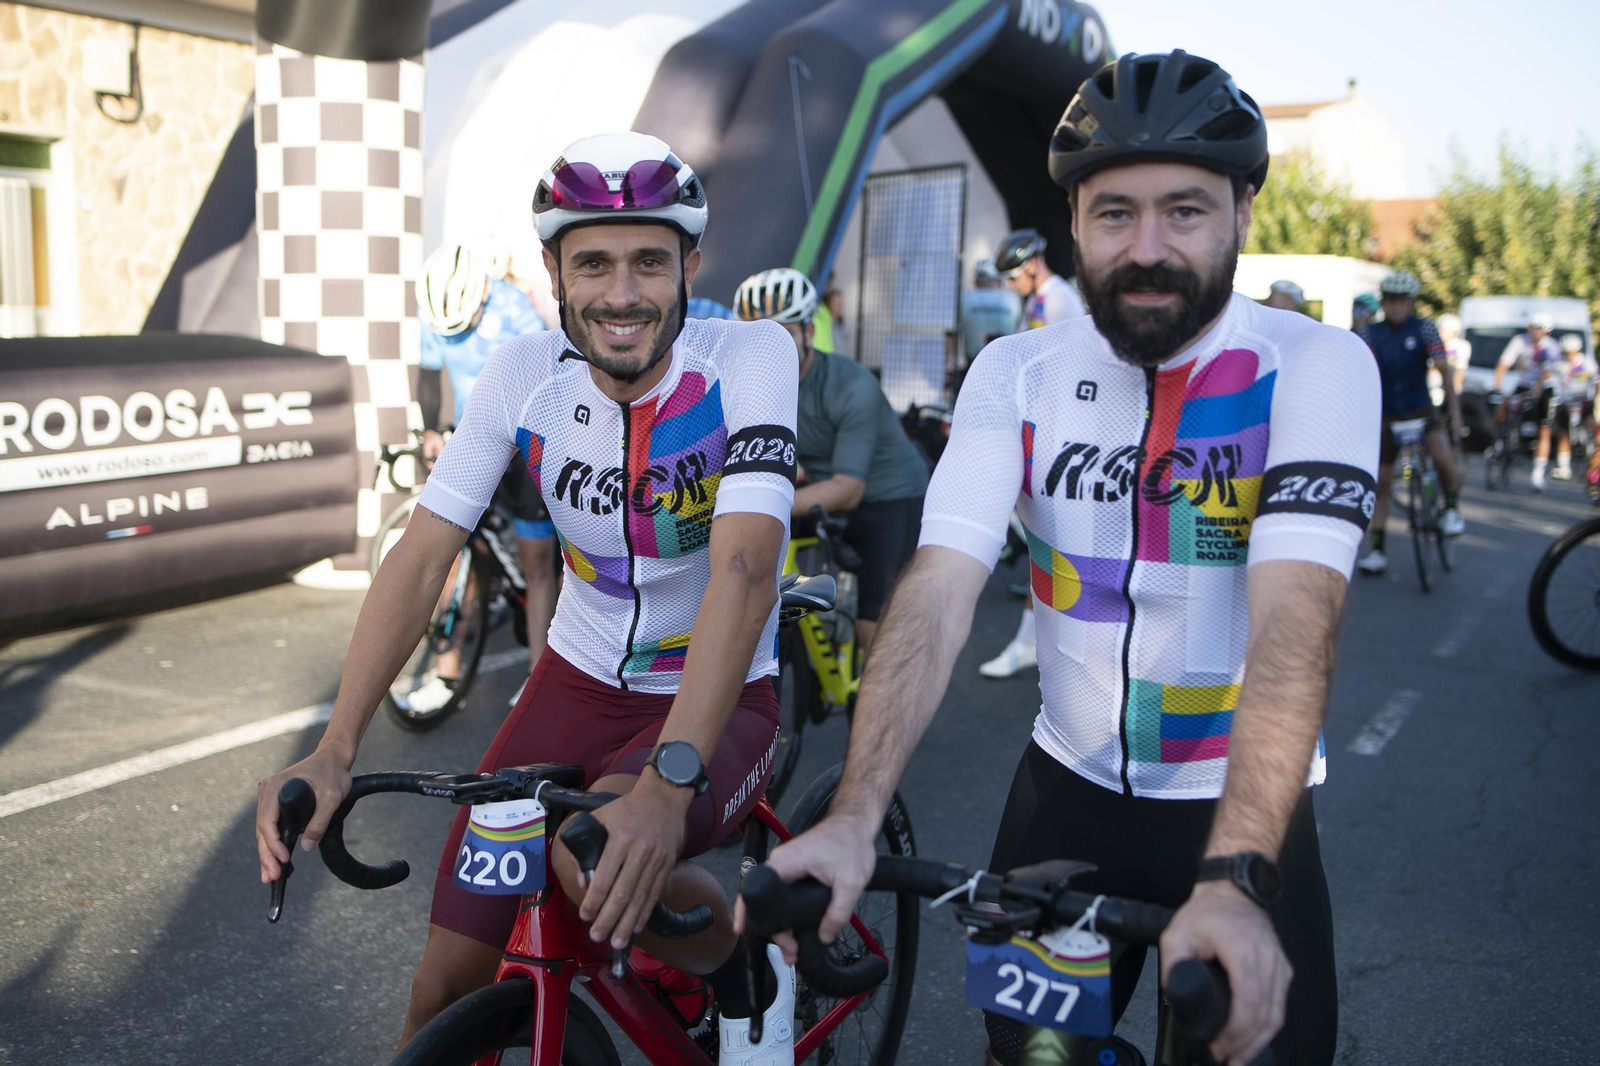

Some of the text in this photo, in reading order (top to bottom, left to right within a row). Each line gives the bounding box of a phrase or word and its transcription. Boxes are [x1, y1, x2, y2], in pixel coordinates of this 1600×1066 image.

[0, 386, 240, 455] RODOSA
[37, 449, 209, 481] www.rodosa.com
[246, 440, 314, 464] DACIA
[724, 437, 796, 467] 2026
[46, 486, 209, 531] ALPINE
[1266, 475, 1377, 519] 2026
[1195, 516, 1249, 527] RIBEIRA
[1195, 528, 1242, 539] SACRA
[1194, 539, 1249, 550] CYCLIN
[1196, 550, 1238, 561] ROAD
[721, 780, 747, 825] BREAK
[746, 762, 760, 796] THE
[458, 843, 528, 887] 220
[994, 963, 1081, 1023] 277
